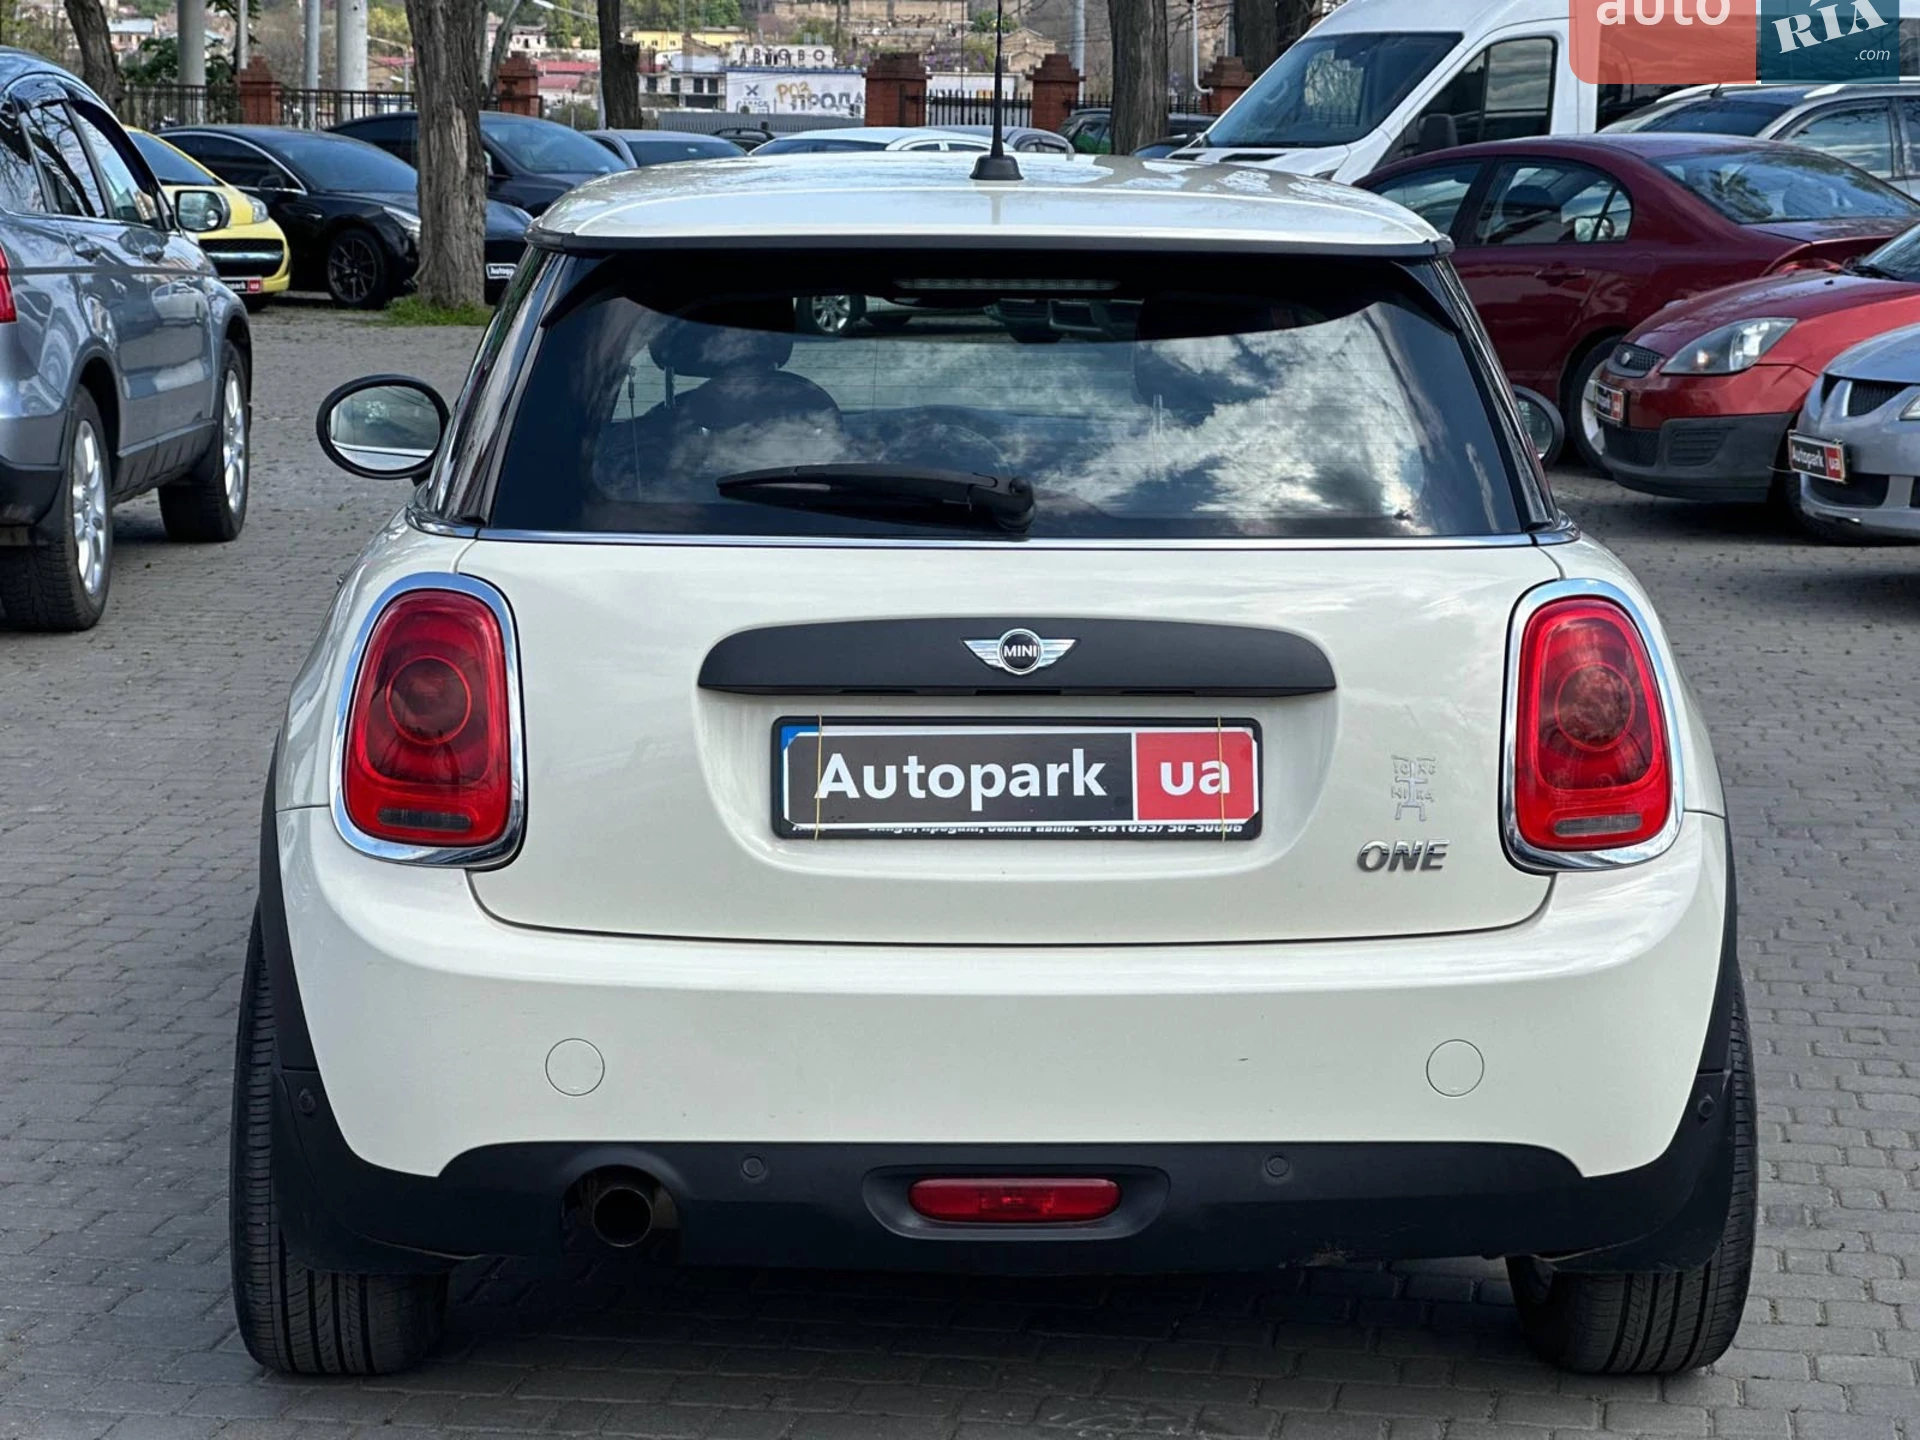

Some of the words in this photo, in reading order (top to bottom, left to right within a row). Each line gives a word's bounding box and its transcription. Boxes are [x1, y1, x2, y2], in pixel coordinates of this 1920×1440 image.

[1003, 644, 1039, 657] MINI
[815, 748, 1107, 811] Autopark
[1160, 759, 1231, 797] ua
[1356, 839, 1450, 873] ONE
